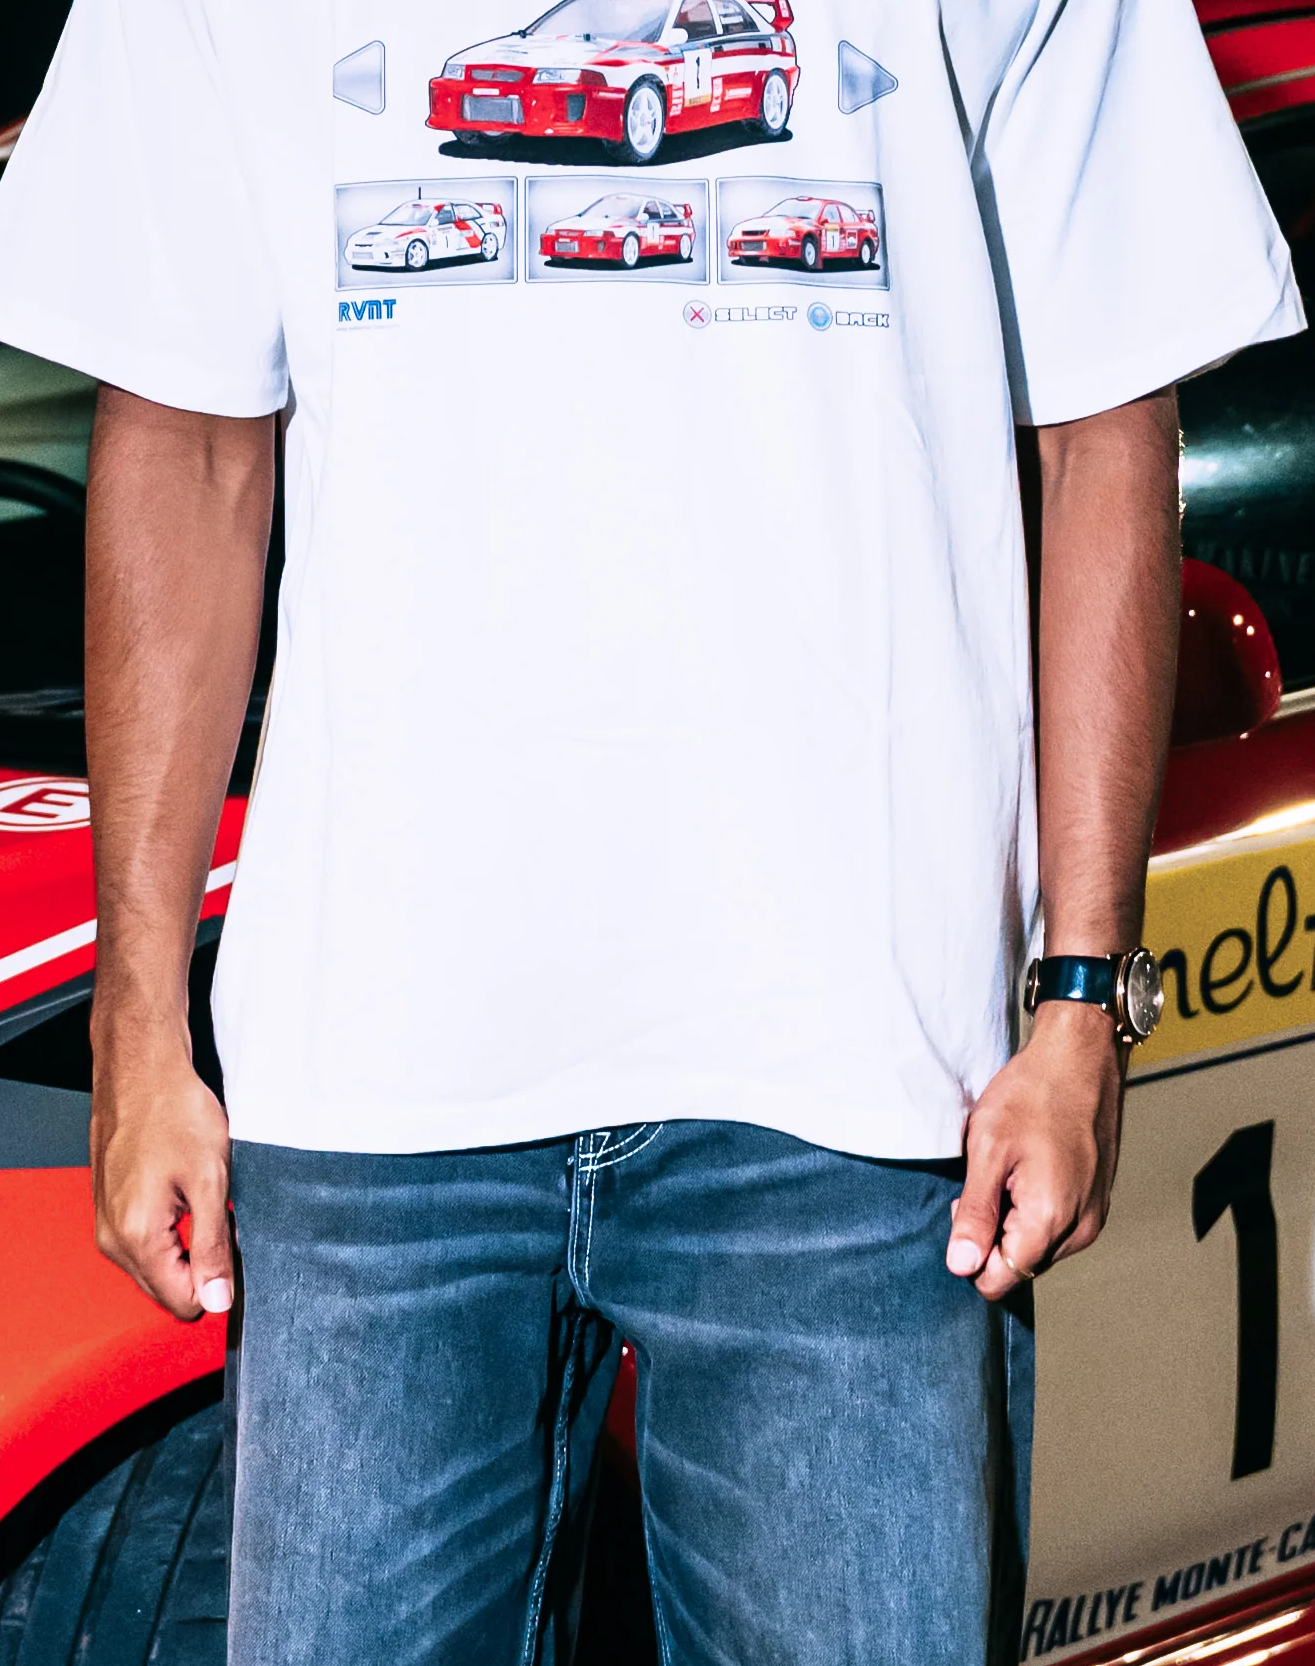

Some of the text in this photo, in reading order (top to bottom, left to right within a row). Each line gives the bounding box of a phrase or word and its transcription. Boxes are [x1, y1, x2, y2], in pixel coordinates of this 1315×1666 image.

[714, 305, 798, 322] SELECT
[835, 311, 890, 328] BACK
[1191, 1119, 1278, 1482] 1
[1019, 1581, 1145, 1663] RALLYE
